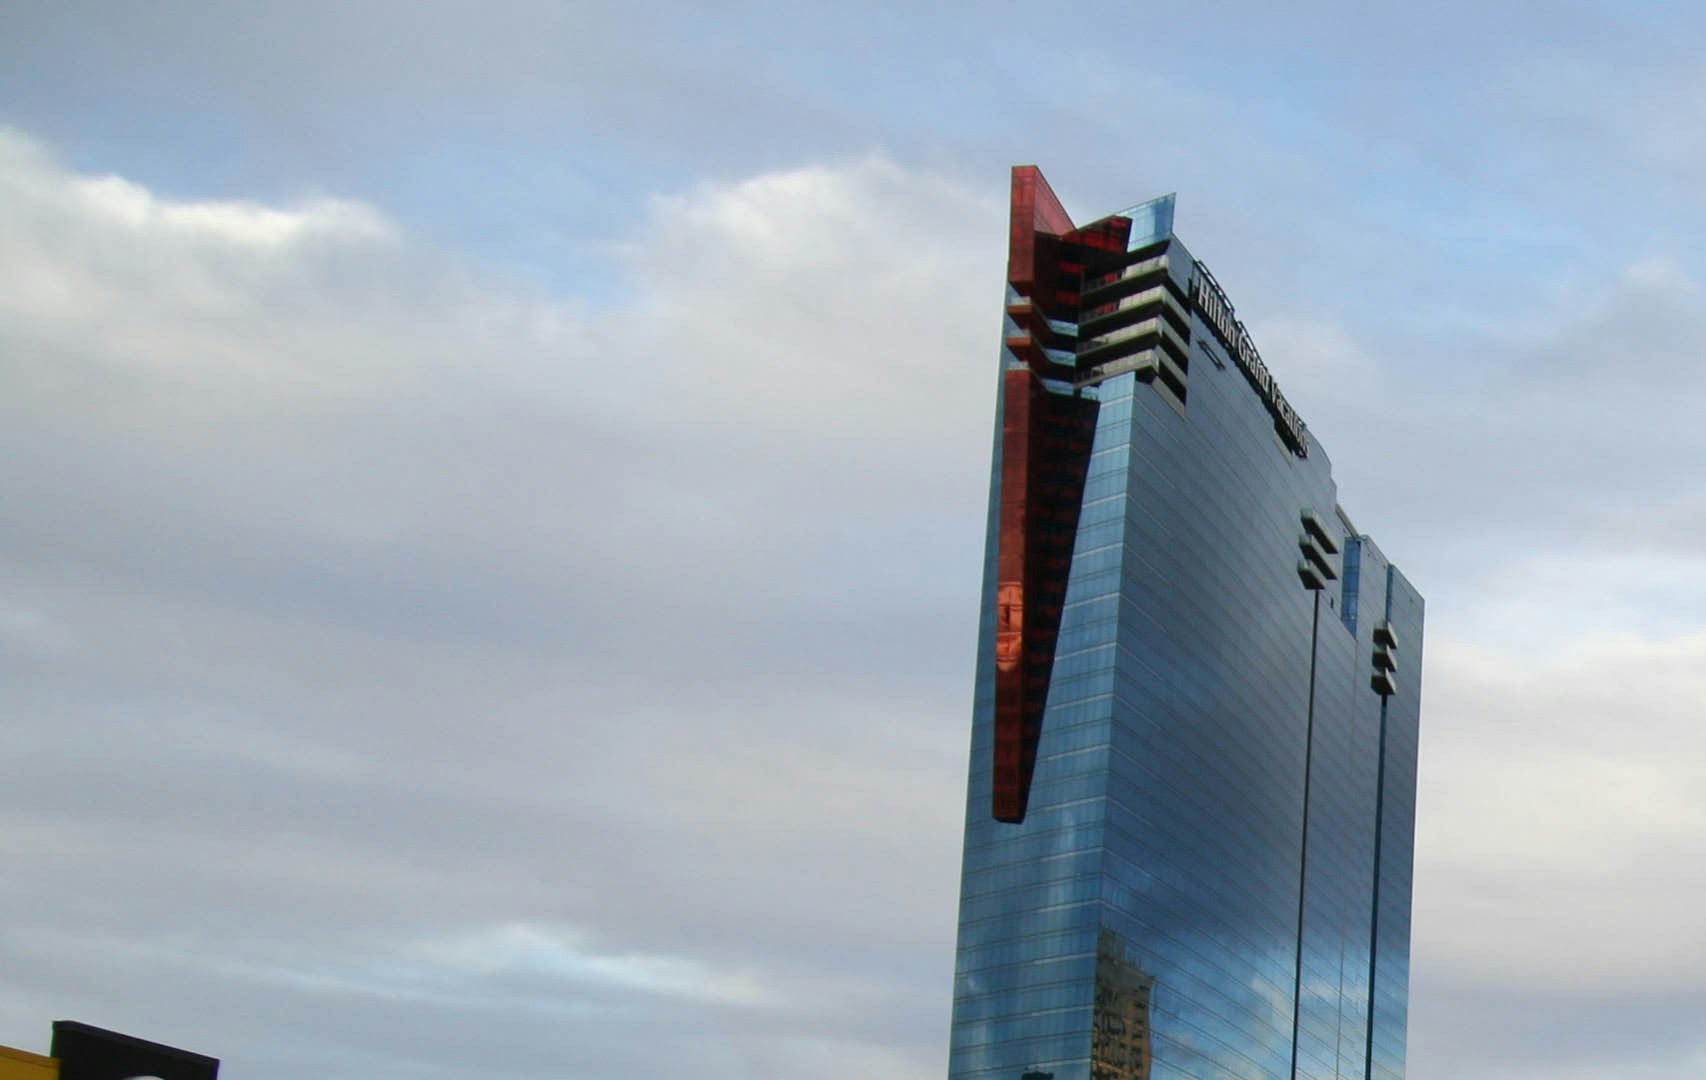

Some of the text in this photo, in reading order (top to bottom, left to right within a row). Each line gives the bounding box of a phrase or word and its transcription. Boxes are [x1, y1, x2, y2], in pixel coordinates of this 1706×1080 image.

[1198, 279, 1309, 457] Hilton Grand Vacations
